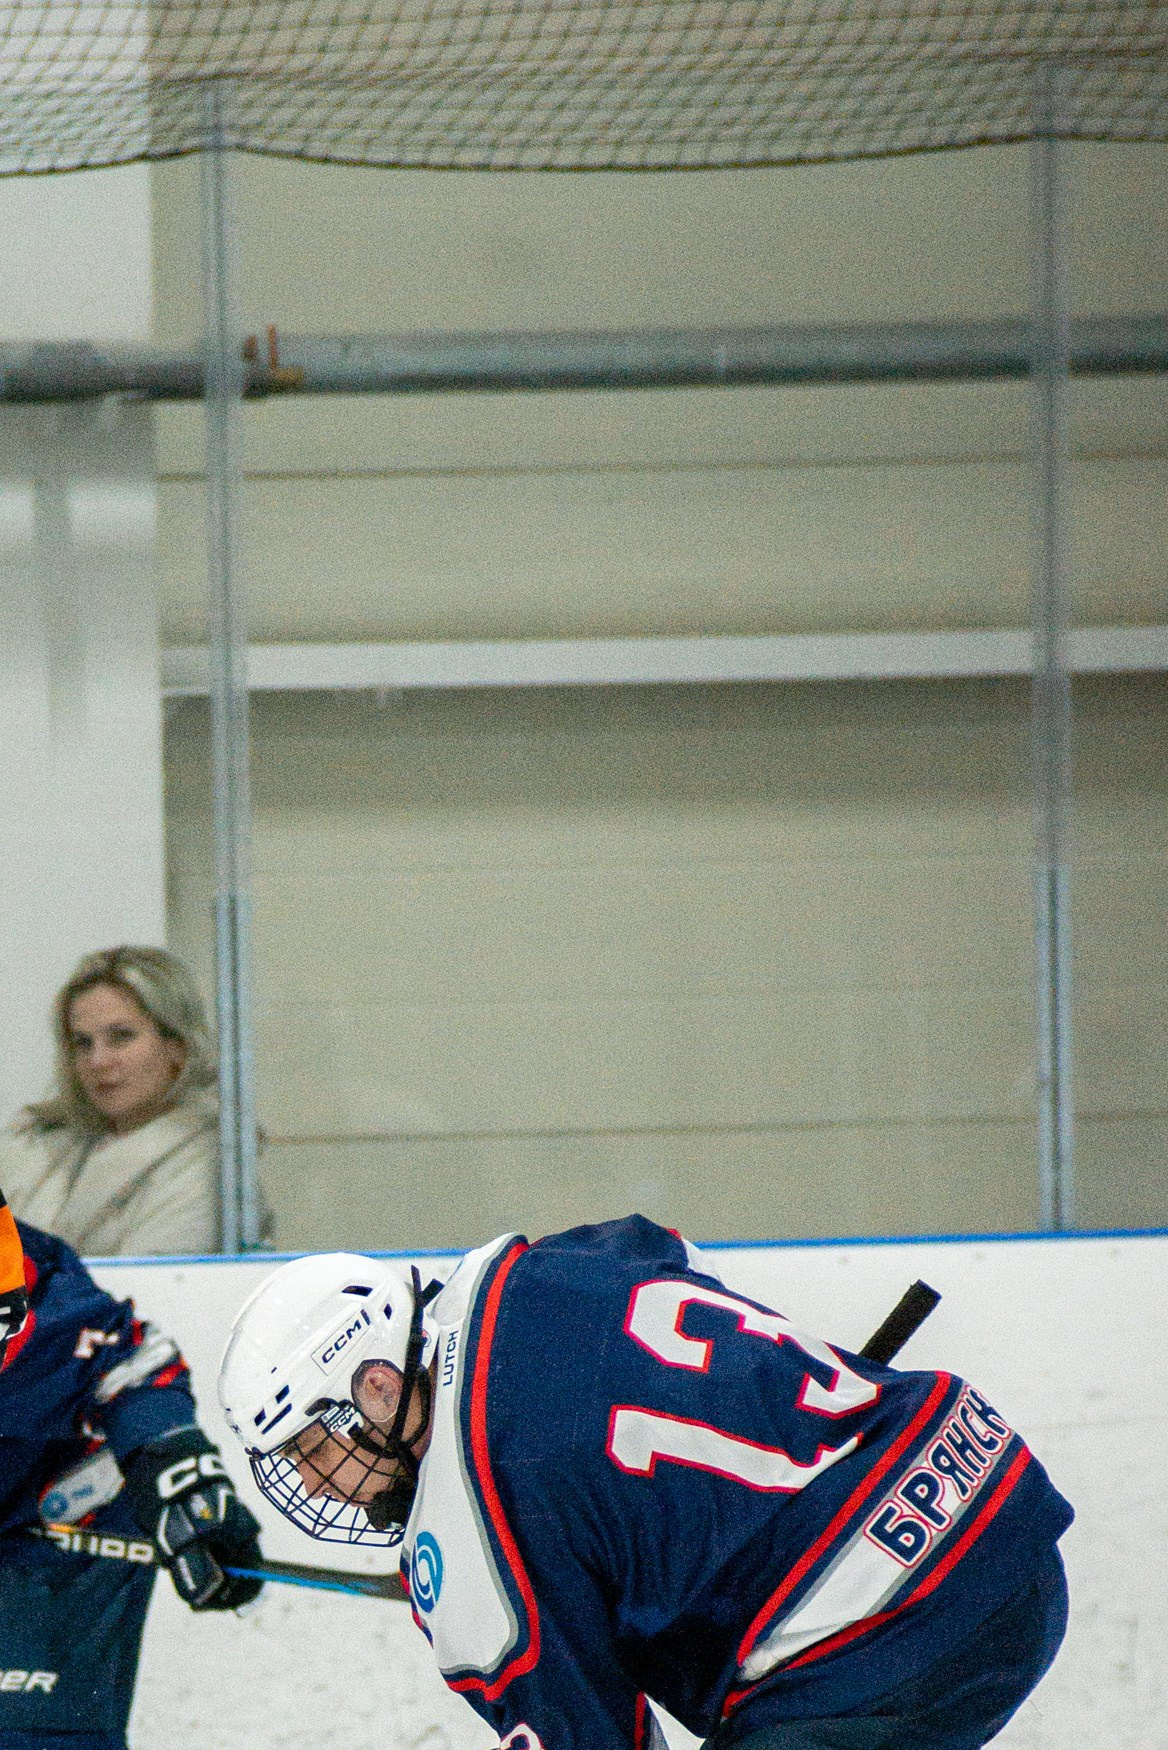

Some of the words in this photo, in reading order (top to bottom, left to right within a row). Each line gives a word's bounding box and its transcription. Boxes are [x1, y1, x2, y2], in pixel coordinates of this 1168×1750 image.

[322, 1319, 363, 1364] CCM
[442, 1329, 460, 1387] LUTCH
[605, 1279, 883, 1495] 13
